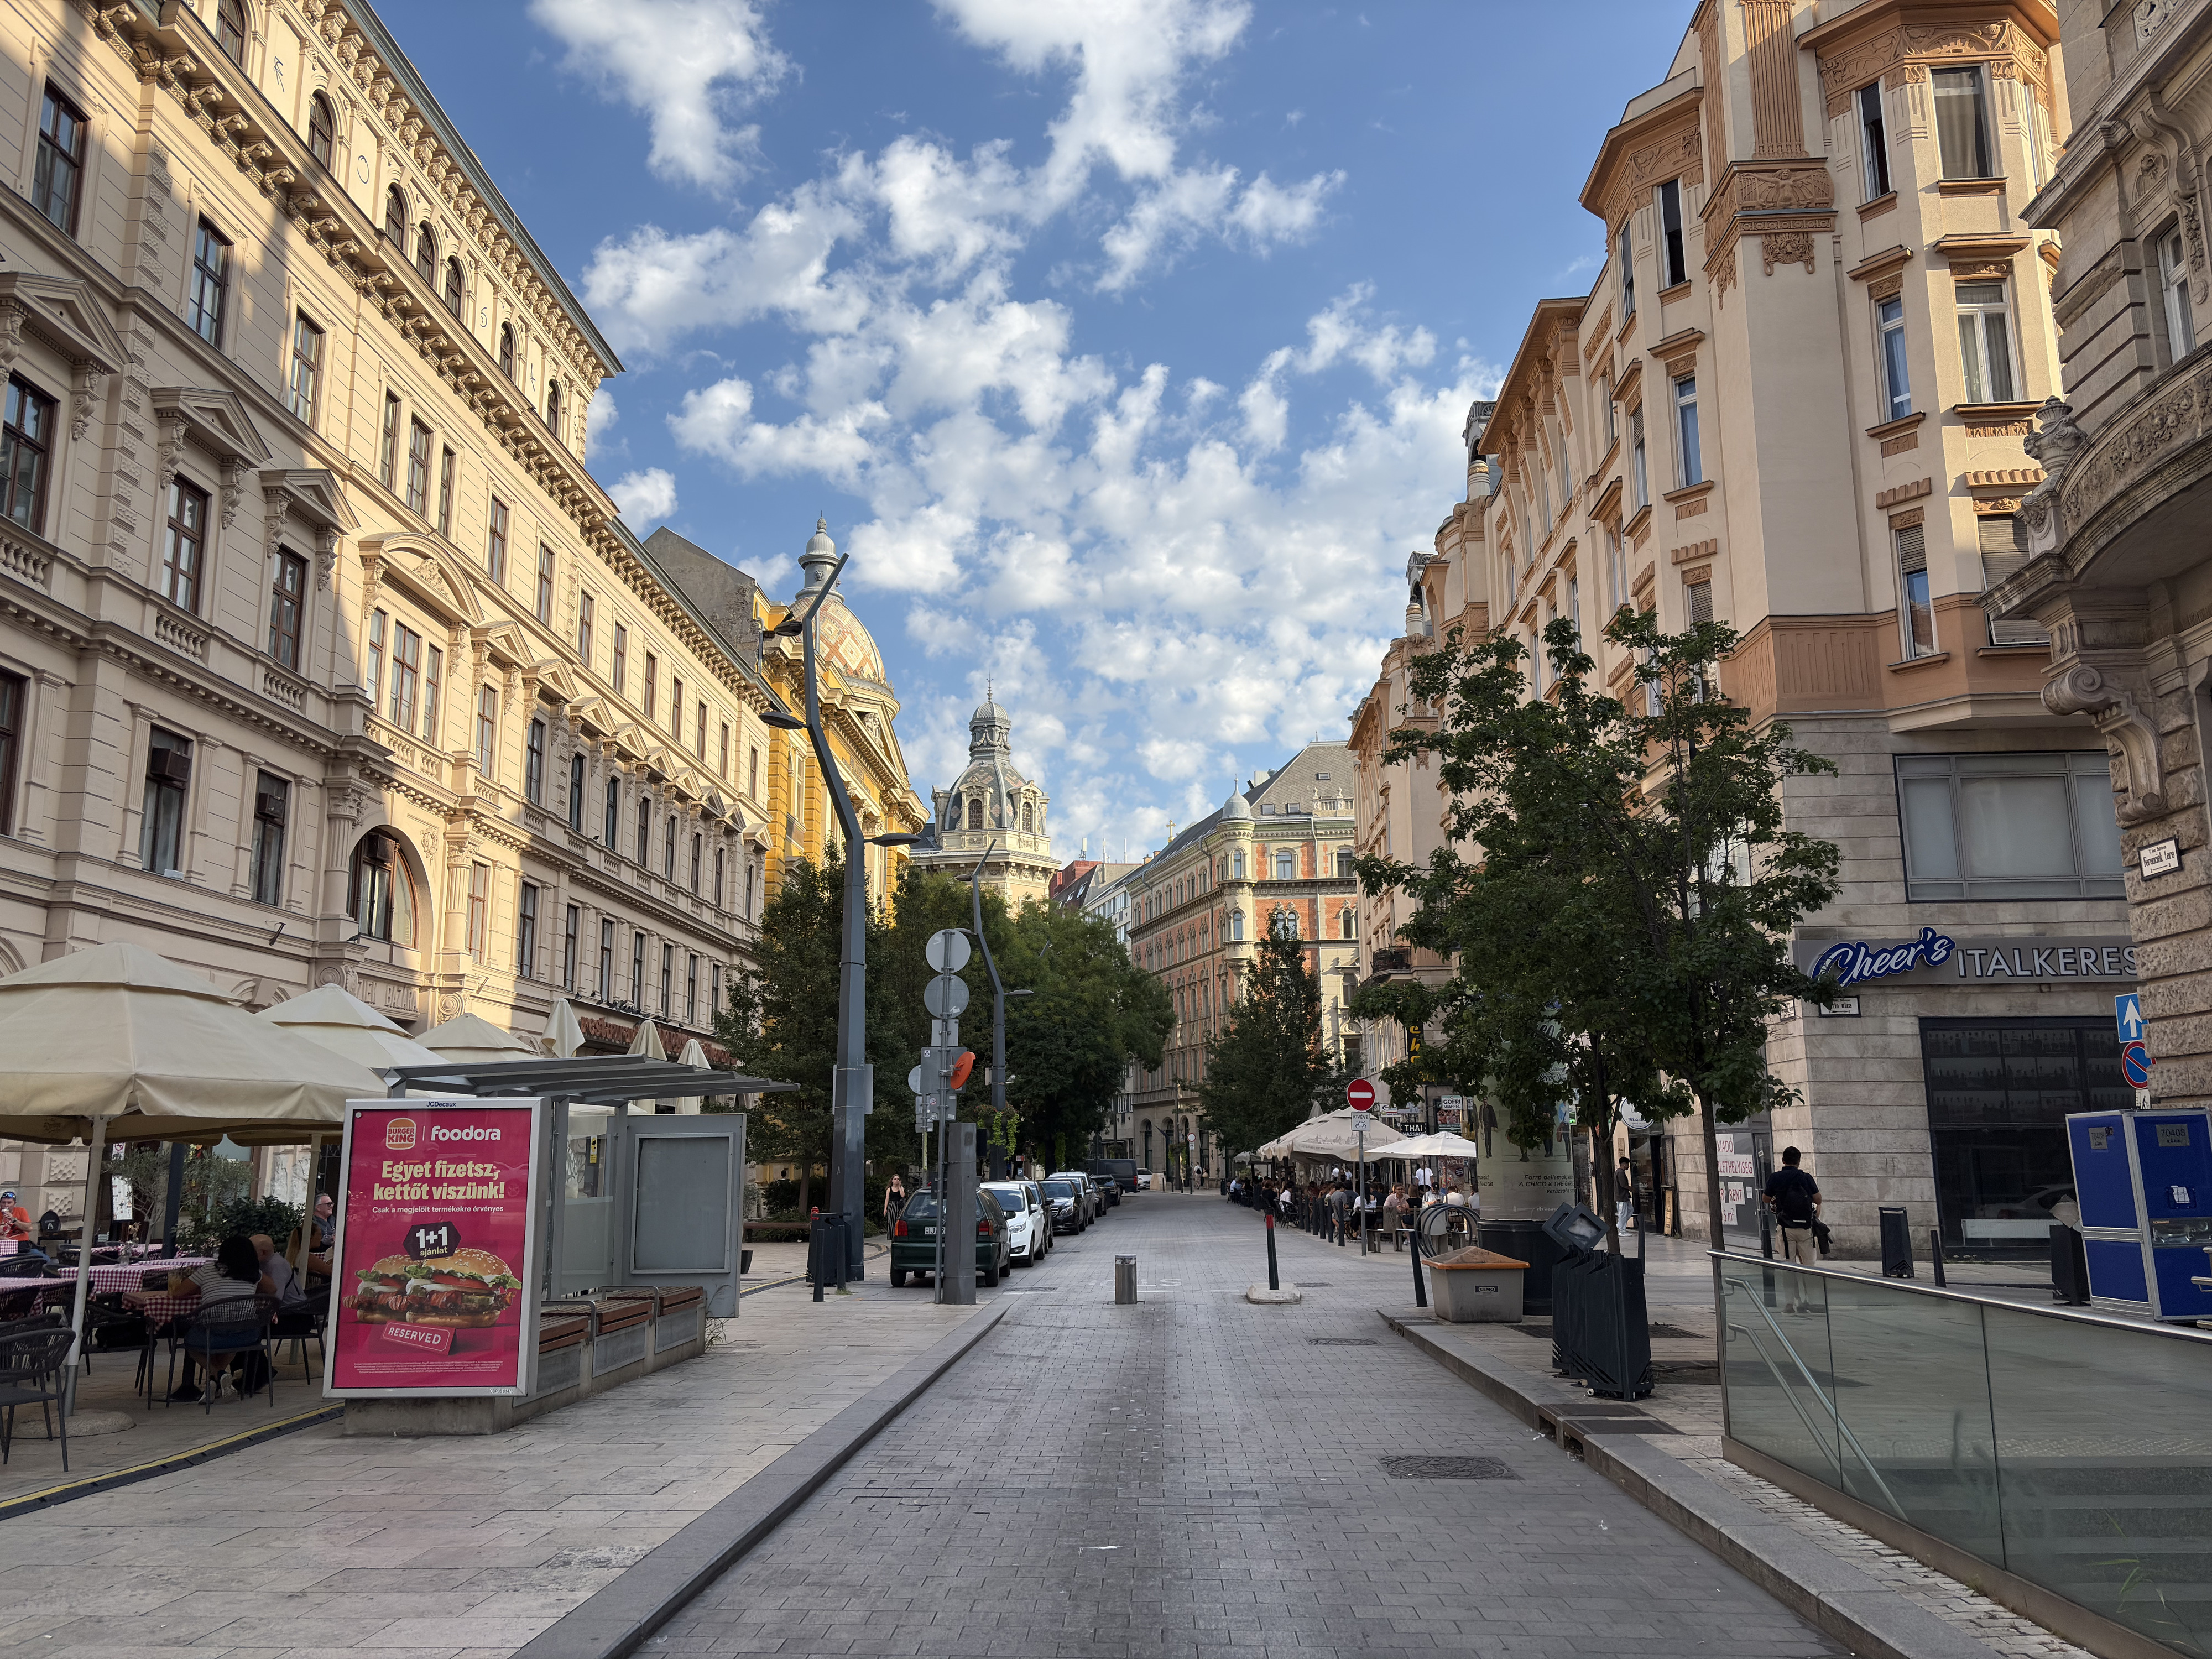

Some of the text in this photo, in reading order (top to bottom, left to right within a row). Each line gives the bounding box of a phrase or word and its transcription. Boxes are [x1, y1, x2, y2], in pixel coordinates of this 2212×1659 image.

[1818, 929, 1953, 987] Cheer's
[388, 1134, 414, 1143] KING
[431, 1125, 501, 1141] foodora
[1717, 1136, 1733, 1153] KIADÓ
[382, 1160, 500, 1182] Egyet fizetsz,
[1718, 1159, 1753, 1174] ZLETHELYISÉG
[373, 1182, 505, 1201] kettőt viszünk!
[1729, 1189, 1742, 1202] RENT
[397, 1206, 430, 1214] megjelölt
[415, 1226, 448, 1249] 1+1
[420, 1246, 448, 1258] ajánlat
[388, 1327, 442, 1345] RESERVED
